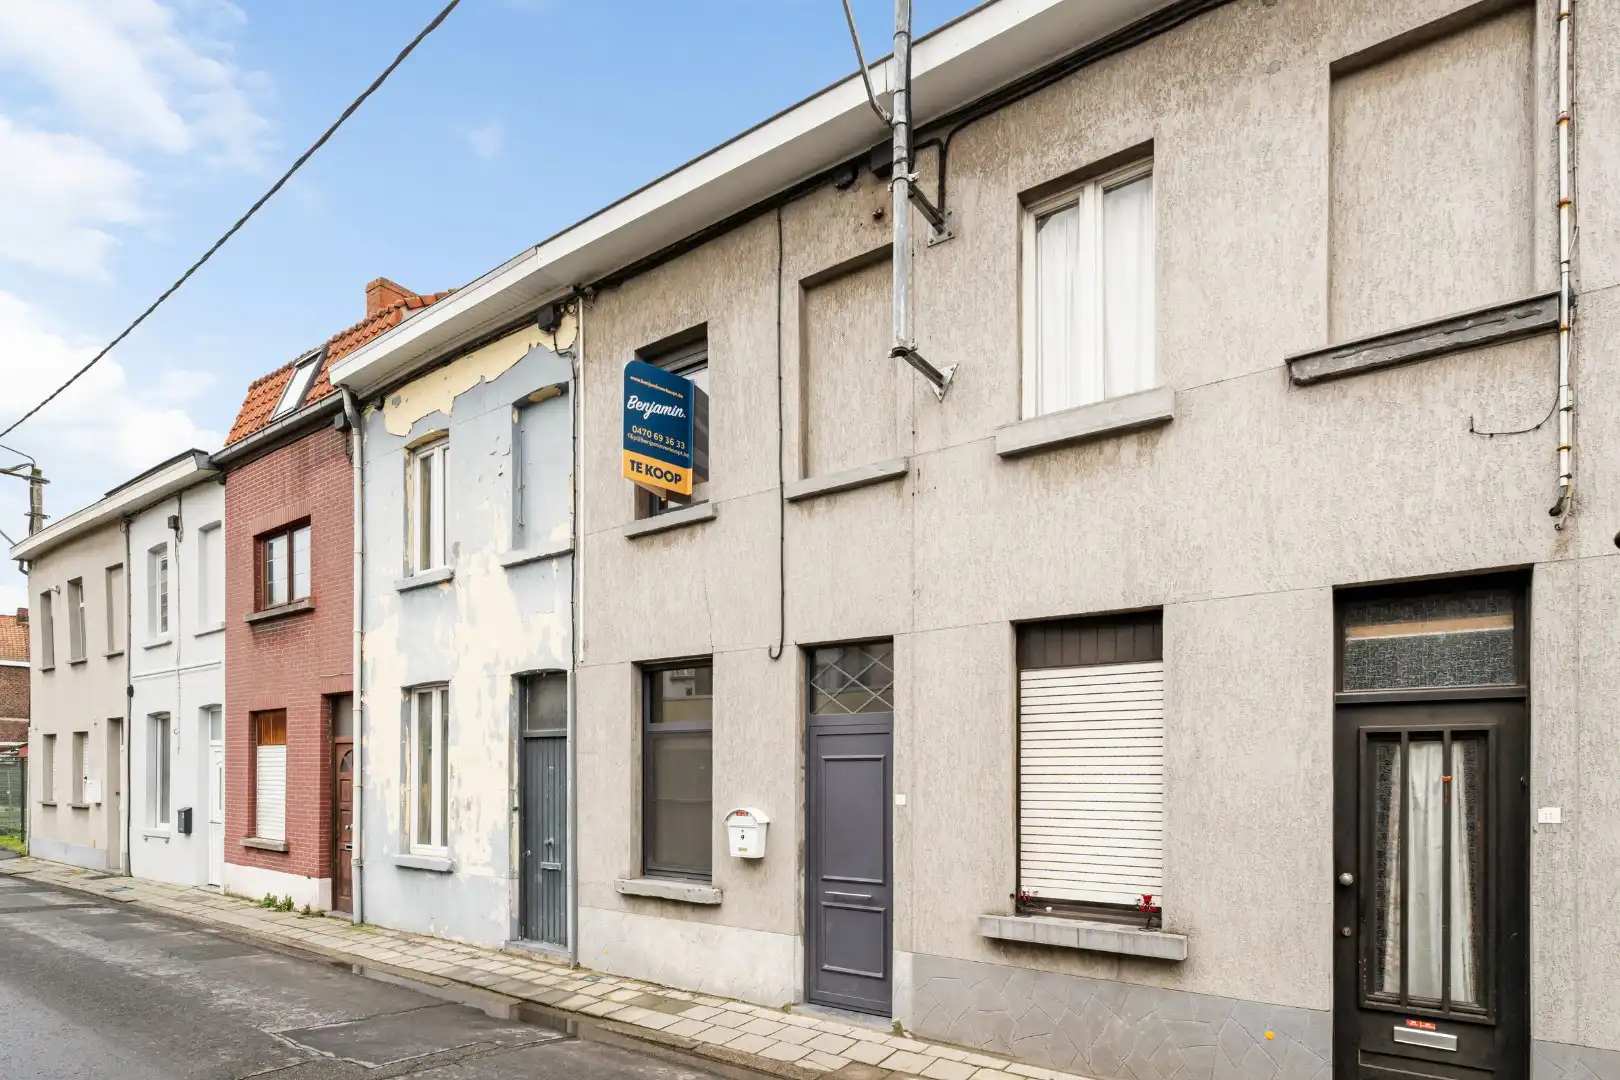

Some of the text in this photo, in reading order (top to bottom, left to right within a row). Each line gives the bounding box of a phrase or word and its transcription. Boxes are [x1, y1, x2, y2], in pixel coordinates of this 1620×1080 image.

[632, 425, 685, 450] 0470 69 36 33
[629, 459, 682, 484] TE KOOP
